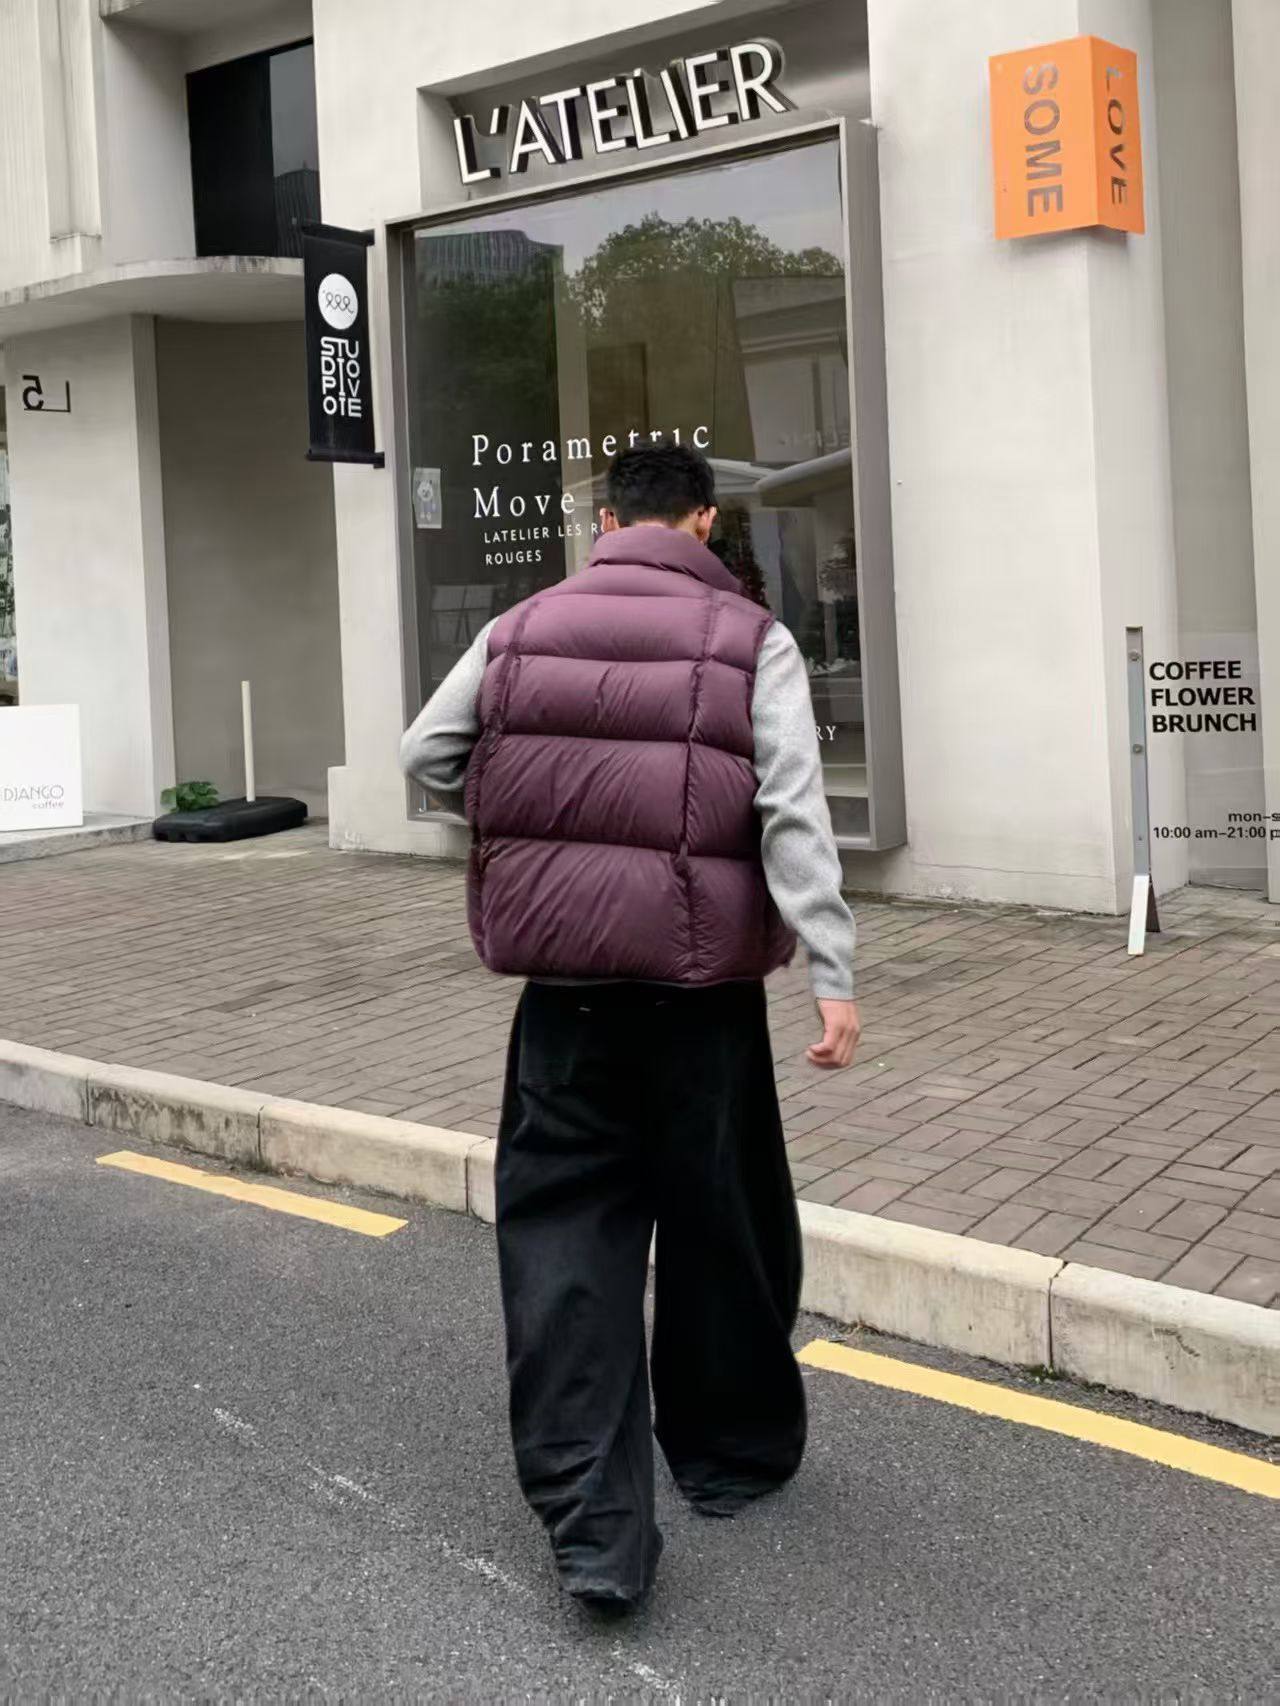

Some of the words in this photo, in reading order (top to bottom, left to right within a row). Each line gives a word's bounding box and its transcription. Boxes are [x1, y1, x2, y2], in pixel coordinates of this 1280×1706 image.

[453, 42, 790, 184] L'ATELIER
[1022, 61, 1064, 218] SOME
[1105, 65, 1128, 206] LOVE
[473, 486, 576, 519] Move
[484, 527, 550, 544] LATELIER
[557, 523, 583, 537] LES
[485, 549, 542, 566] ROUGES
[1149, 660, 1242, 681] COFFEE
[1151, 687, 1256, 707] FLOWER
[1152, 713, 1257, 733] BRUNCH
[1152, 826, 1191, 839] 10:00
